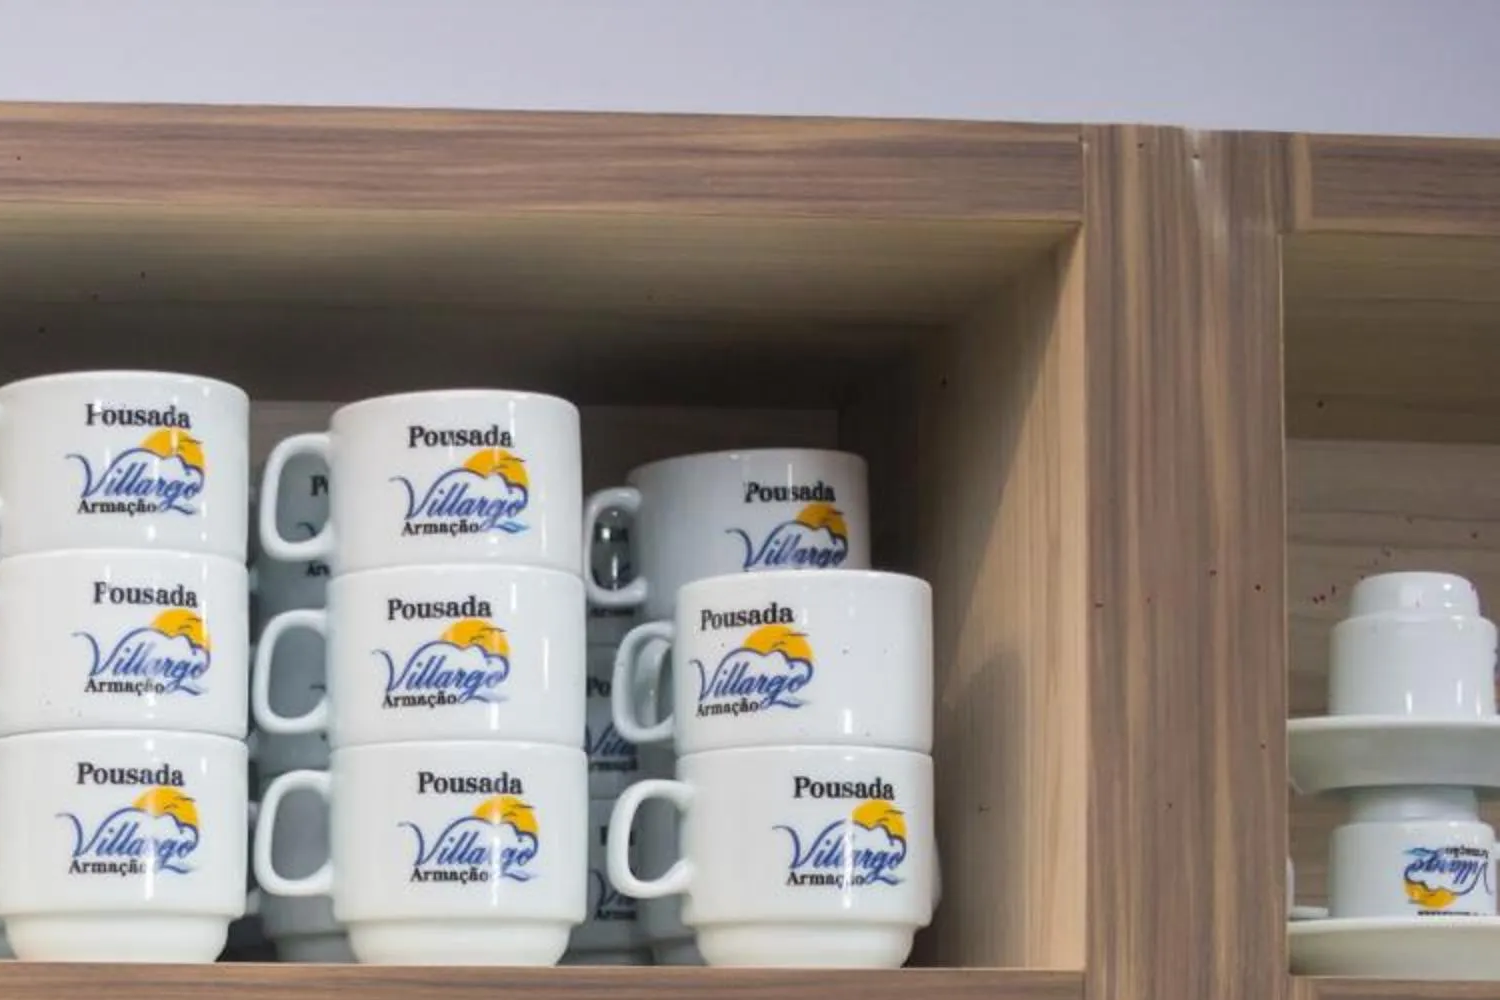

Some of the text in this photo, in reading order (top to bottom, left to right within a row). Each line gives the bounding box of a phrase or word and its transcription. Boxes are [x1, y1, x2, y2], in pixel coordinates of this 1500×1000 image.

[408, 424, 513, 449] Pousada
[744, 481, 837, 504] Pousada
[79, 499, 157, 516] Armação
[403, 521, 480, 537] Armação
[387, 594, 493, 621] Pousada
[700, 601, 795, 632] Pousada
[383, 691, 457, 708] Armação
[696, 699, 760, 717] Armação
[76, 761, 186, 788] Pousada
[417, 771, 524, 796] Pousada
[793, 775, 896, 801] Pousada
[55, 807, 199, 873] Villago
[398, 816, 539, 881] Villago
[410, 866, 489, 883] Armação
[787, 871, 867, 887] Armaço
